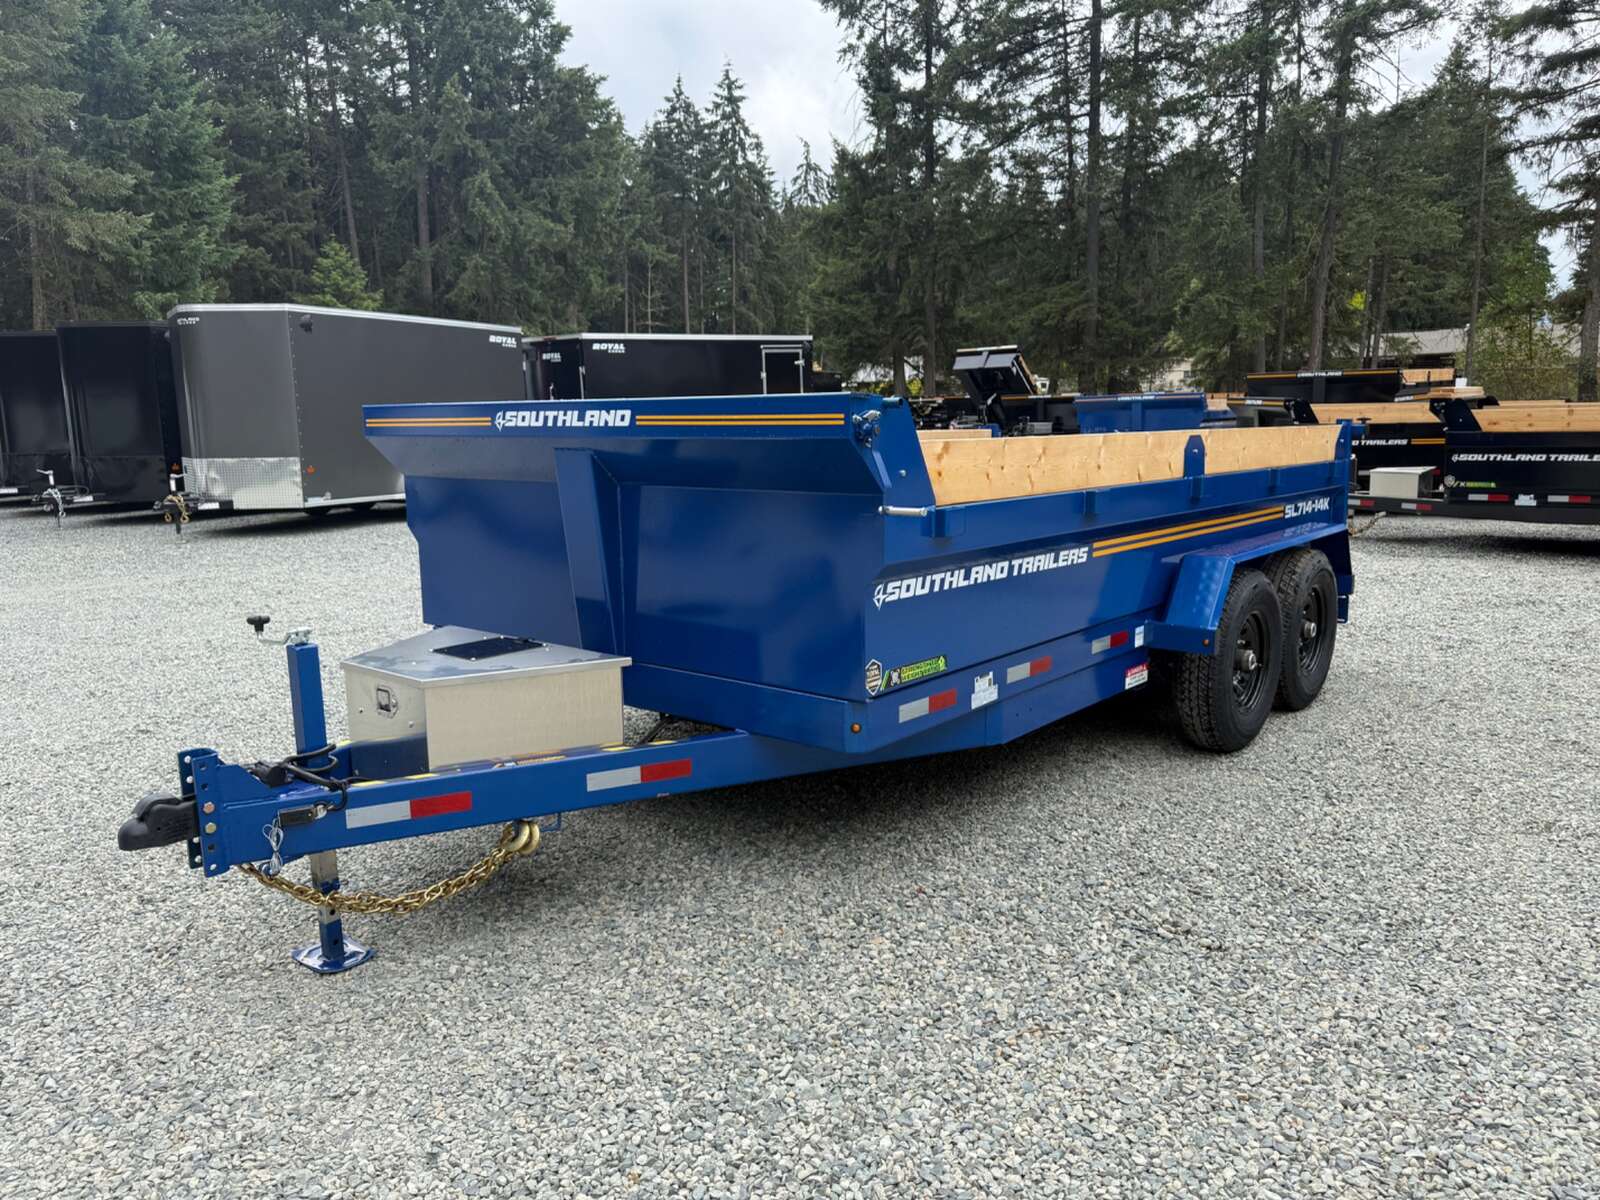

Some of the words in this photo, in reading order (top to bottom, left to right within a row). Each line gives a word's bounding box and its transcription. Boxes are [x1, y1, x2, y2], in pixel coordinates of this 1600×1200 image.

[489, 334, 517, 345] ROYAL
[592, 343, 625, 351] ROYAL
[504, 409, 632, 427] SOUTHLAND
[1460, 453, 1547, 461] SOUTHLAND
[1284, 497, 1330, 519] SL714-14K
[885, 560, 1010, 602] SOUTHLAND
[1011, 547, 1089, 576] TRAILERS
